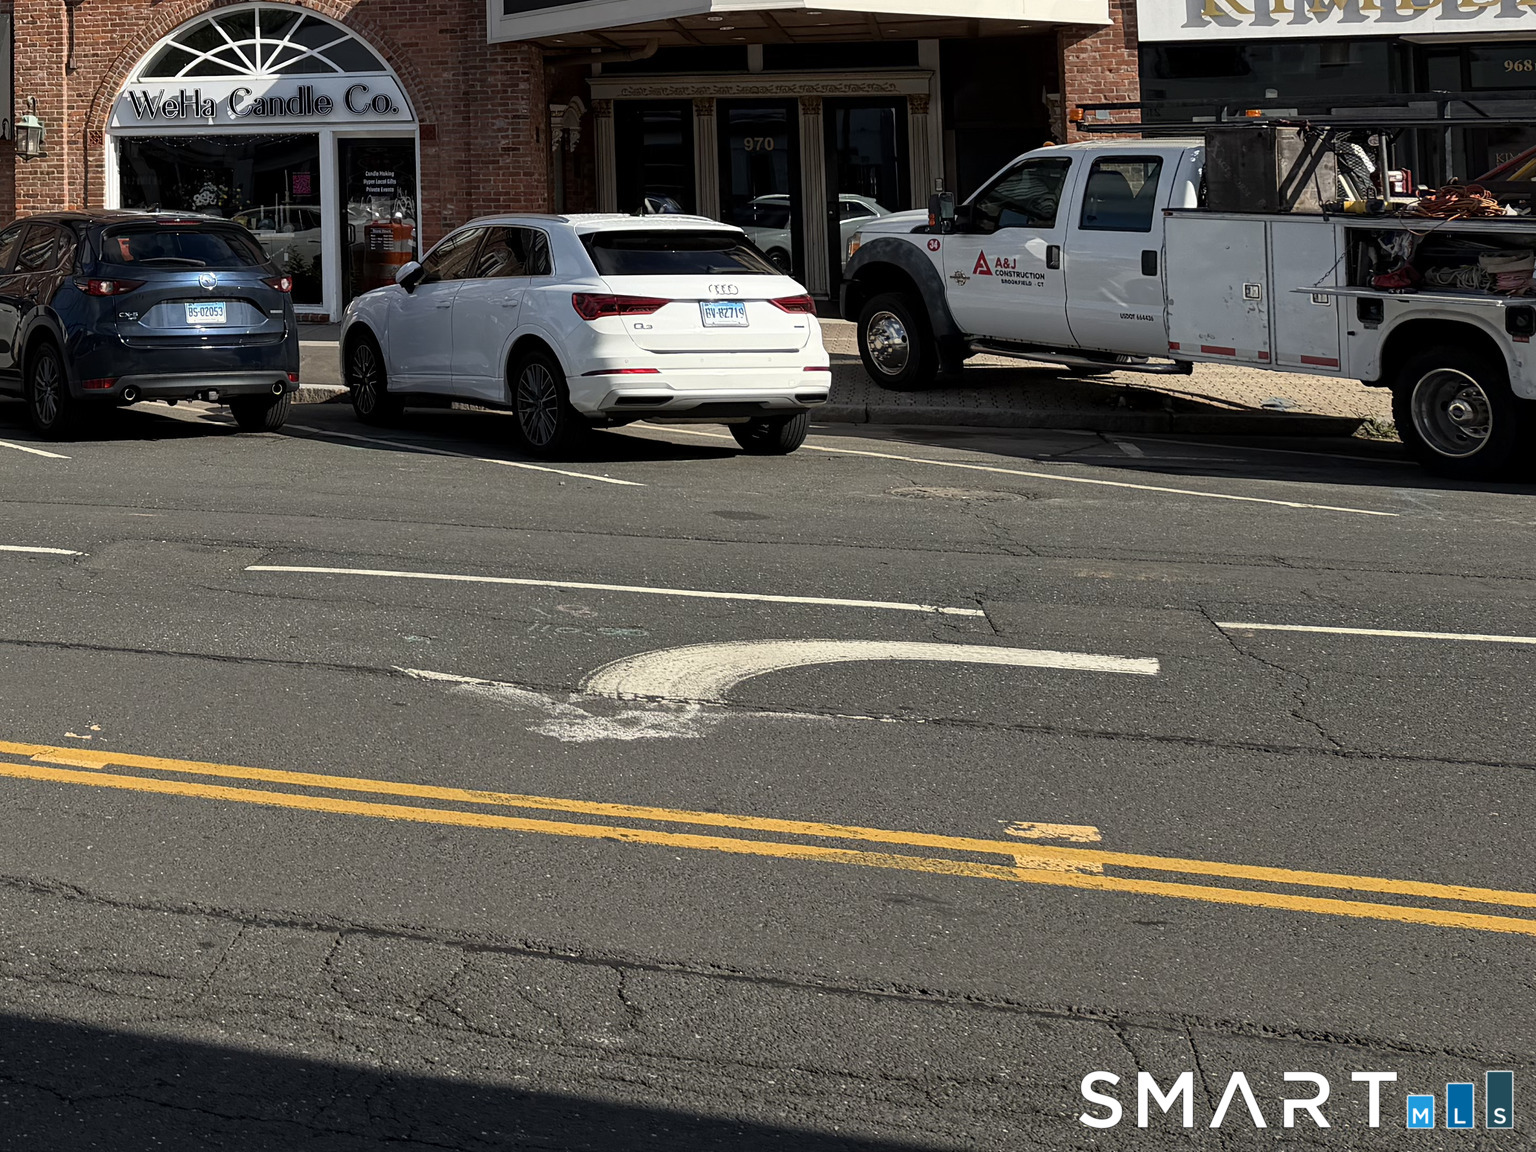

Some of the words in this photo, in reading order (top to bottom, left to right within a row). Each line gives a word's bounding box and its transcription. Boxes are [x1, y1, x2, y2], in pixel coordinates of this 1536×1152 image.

[128, 87, 217, 119] WeHa
[229, 84, 333, 118] Candle
[345, 84, 399, 115] Co.
[744, 137, 775, 151] 970
[929, 239, 938, 249] 34
[994, 257, 1017, 270] A&J
[994, 269, 1045, 280] CONSTRUCTION
